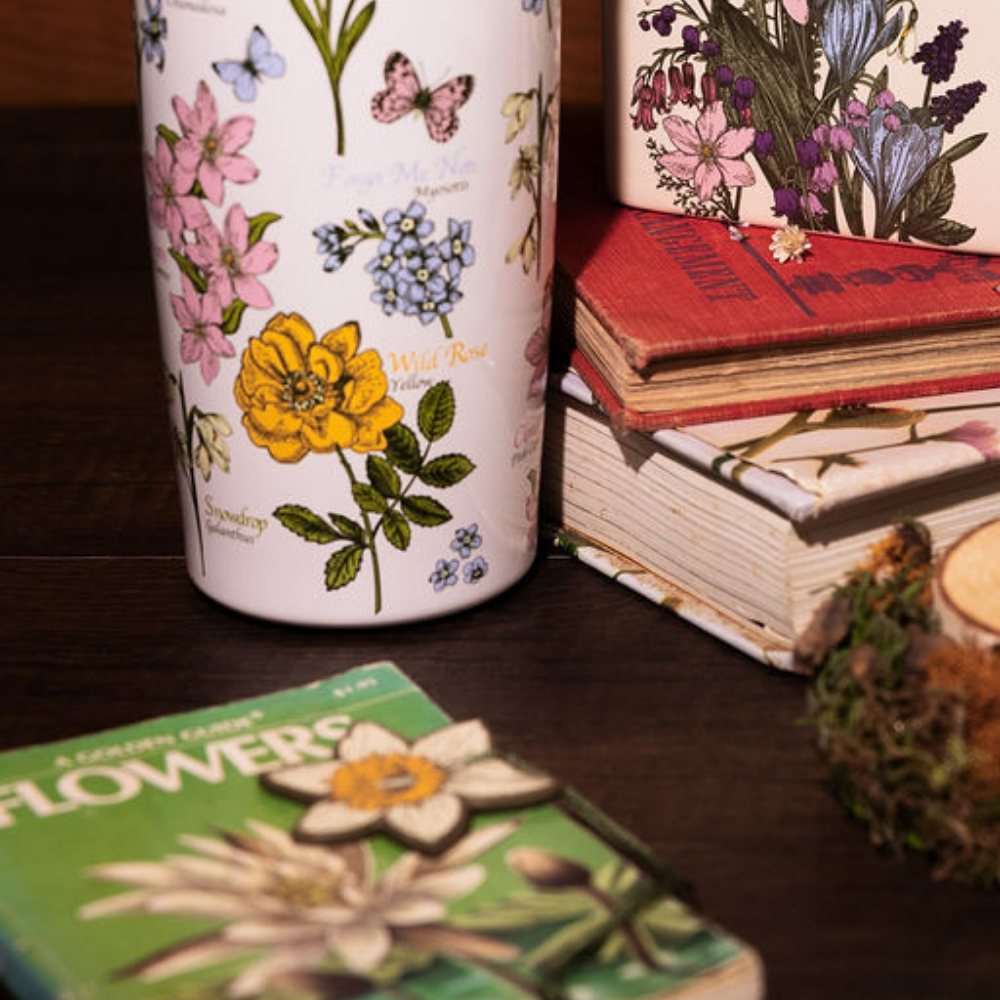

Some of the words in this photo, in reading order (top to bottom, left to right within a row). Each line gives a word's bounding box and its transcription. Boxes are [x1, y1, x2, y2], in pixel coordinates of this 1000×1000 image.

[635, 210, 758, 301] ANGEMENT
[389, 345, 441, 375] Wild
[444, 340, 489, 368] Rose
[204, 493, 268, 539] Snowdrop
